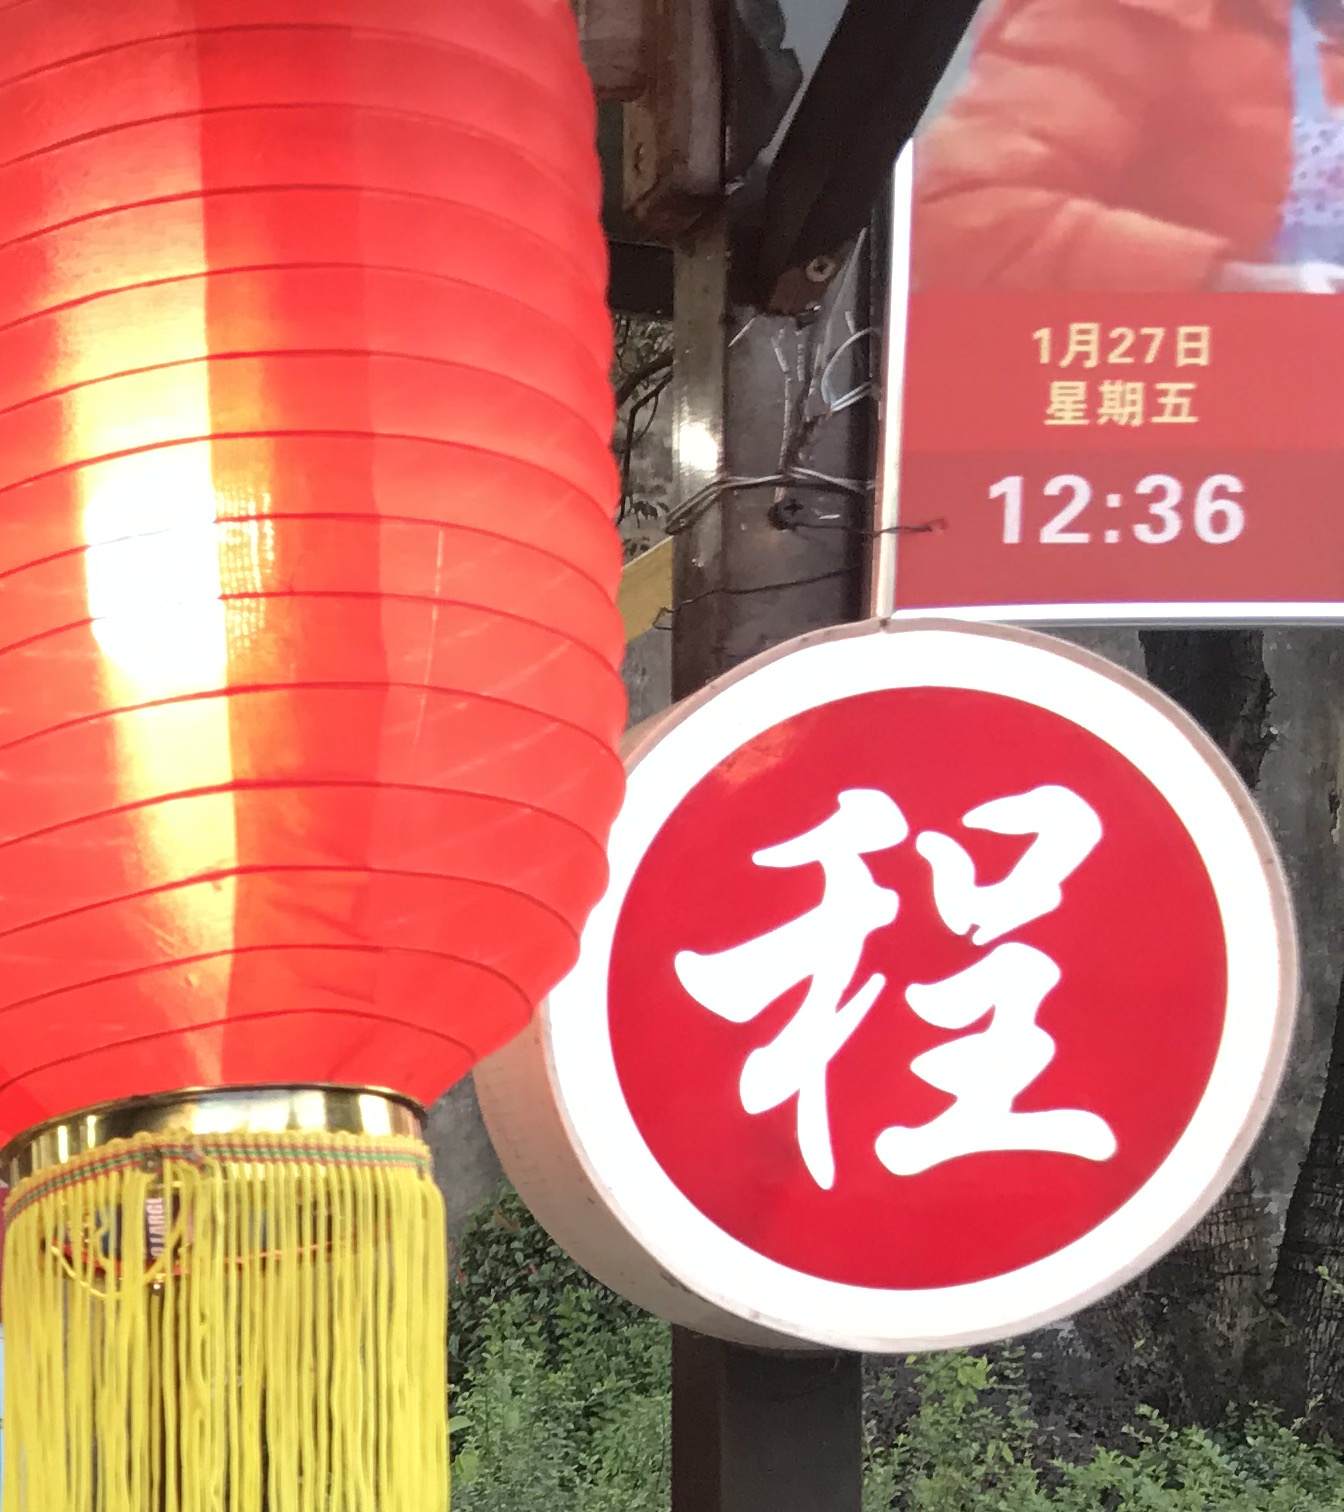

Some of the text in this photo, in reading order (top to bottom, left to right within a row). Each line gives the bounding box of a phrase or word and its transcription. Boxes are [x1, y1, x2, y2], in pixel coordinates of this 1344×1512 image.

[1031, 321, 1211, 368] 1月27日
[1044, 380, 1199, 426] 星期五
[988, 473, 1246, 544] 12:36
[673, 783, 1118, 1190] 程
